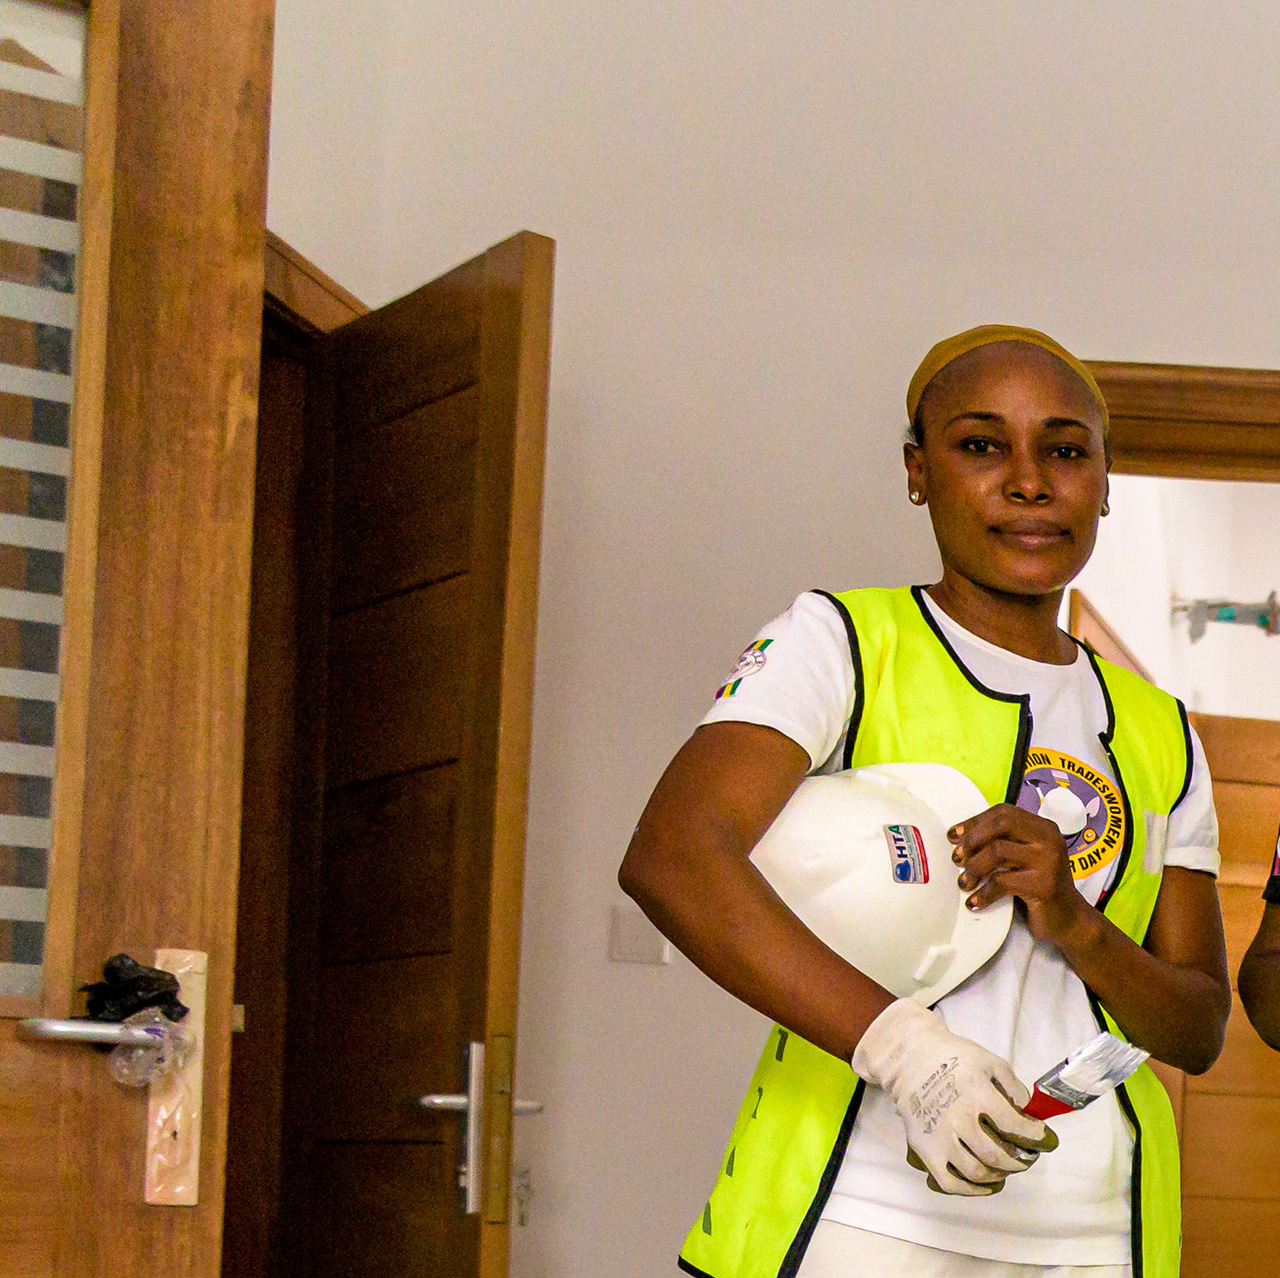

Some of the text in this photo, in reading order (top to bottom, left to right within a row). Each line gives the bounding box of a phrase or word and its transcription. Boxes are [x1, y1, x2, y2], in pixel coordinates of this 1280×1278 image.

[1059, 757, 1122, 849] TRADESWOMEN
[888, 825, 908, 858] HTA
[1079, 848, 1102, 871] DAY
